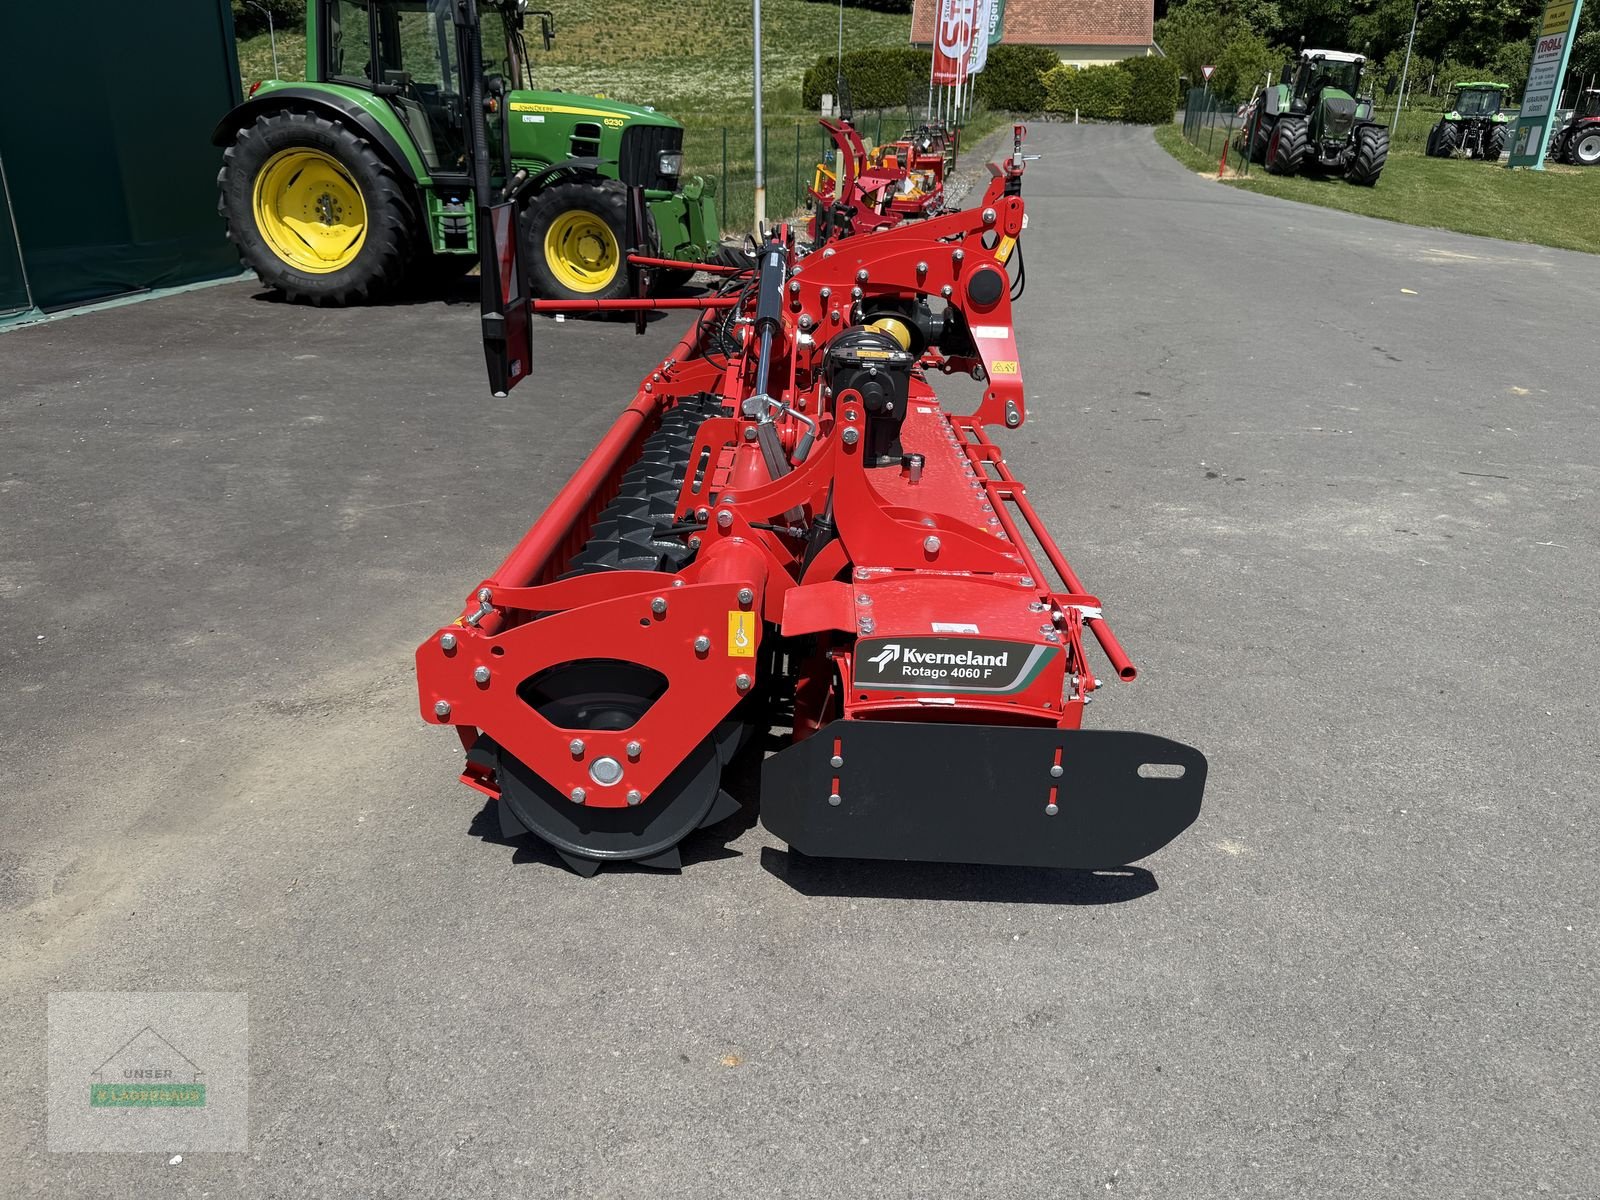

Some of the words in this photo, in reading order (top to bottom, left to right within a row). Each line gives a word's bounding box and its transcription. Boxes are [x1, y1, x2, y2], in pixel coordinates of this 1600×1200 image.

[1538, 37, 1562, 53] MOLL
[604, 118, 624, 126] 6230
[903, 648, 1008, 667] Kverneland
[902, 666, 947, 679] Rotago
[950, 668, 980, 678] 4060
[984, 669, 992, 679] F
